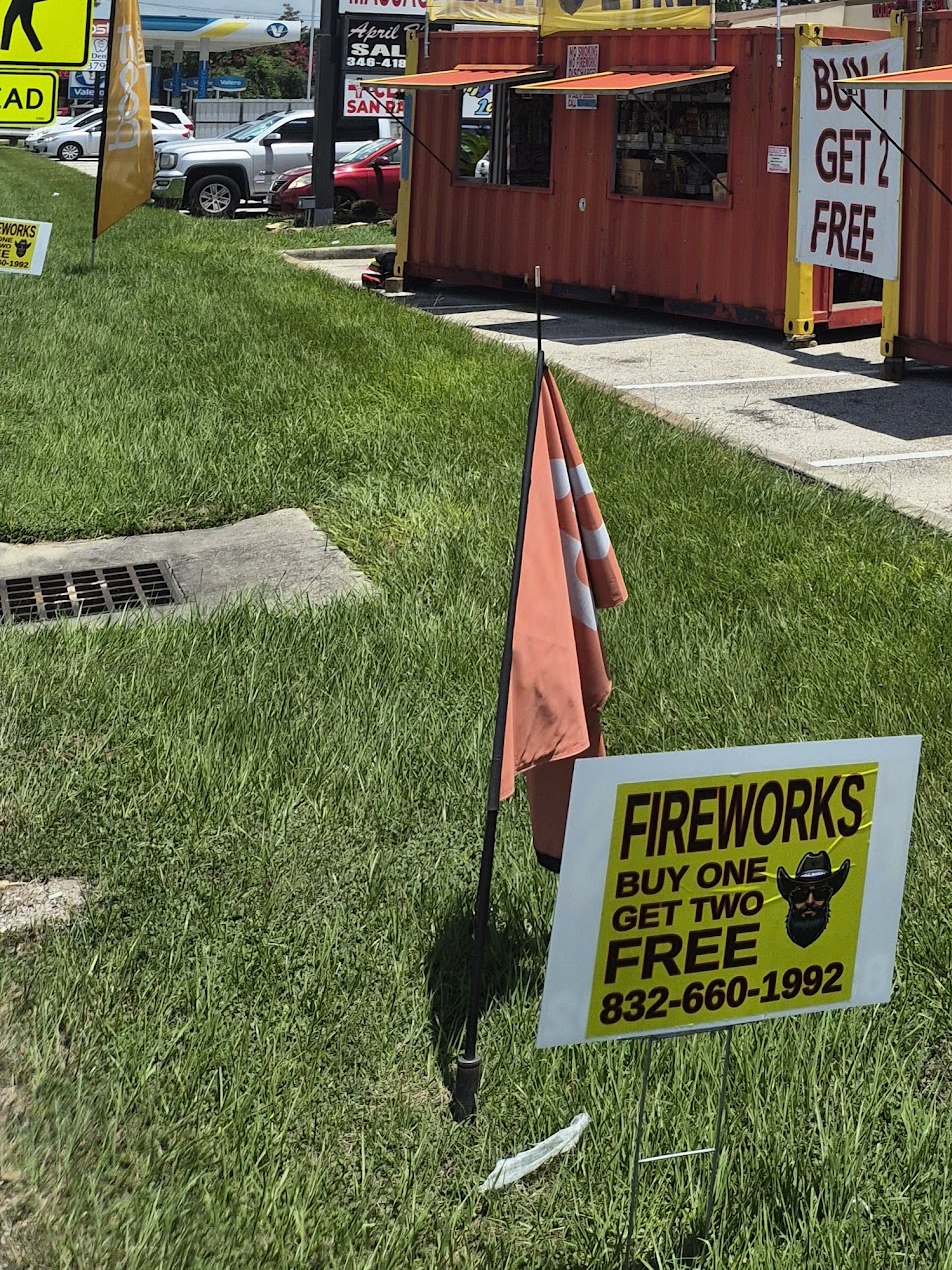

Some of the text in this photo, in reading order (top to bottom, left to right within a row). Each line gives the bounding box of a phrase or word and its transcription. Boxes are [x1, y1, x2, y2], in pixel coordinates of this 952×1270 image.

[347, 21, 400, 43] April
[0, 87, 44, 109] AD
[74, 88, 104, 96] Valeo
[812, 52, 889, 112] BUY 1
[347, 99, 380, 114] SAN
[815, 127, 889, 189] GET 2
[0, 221, 36, 238] WORKS
[810, 199, 877, 264] FREE
[619, 772, 866, 861] FIREWORKS
[615, 856, 769, 899] BUY ONE
[611, 890, 765, 933] GET TWO
[603, 922, 761, 985] FREE
[599, 961, 845, 1026] 832-660-1992
